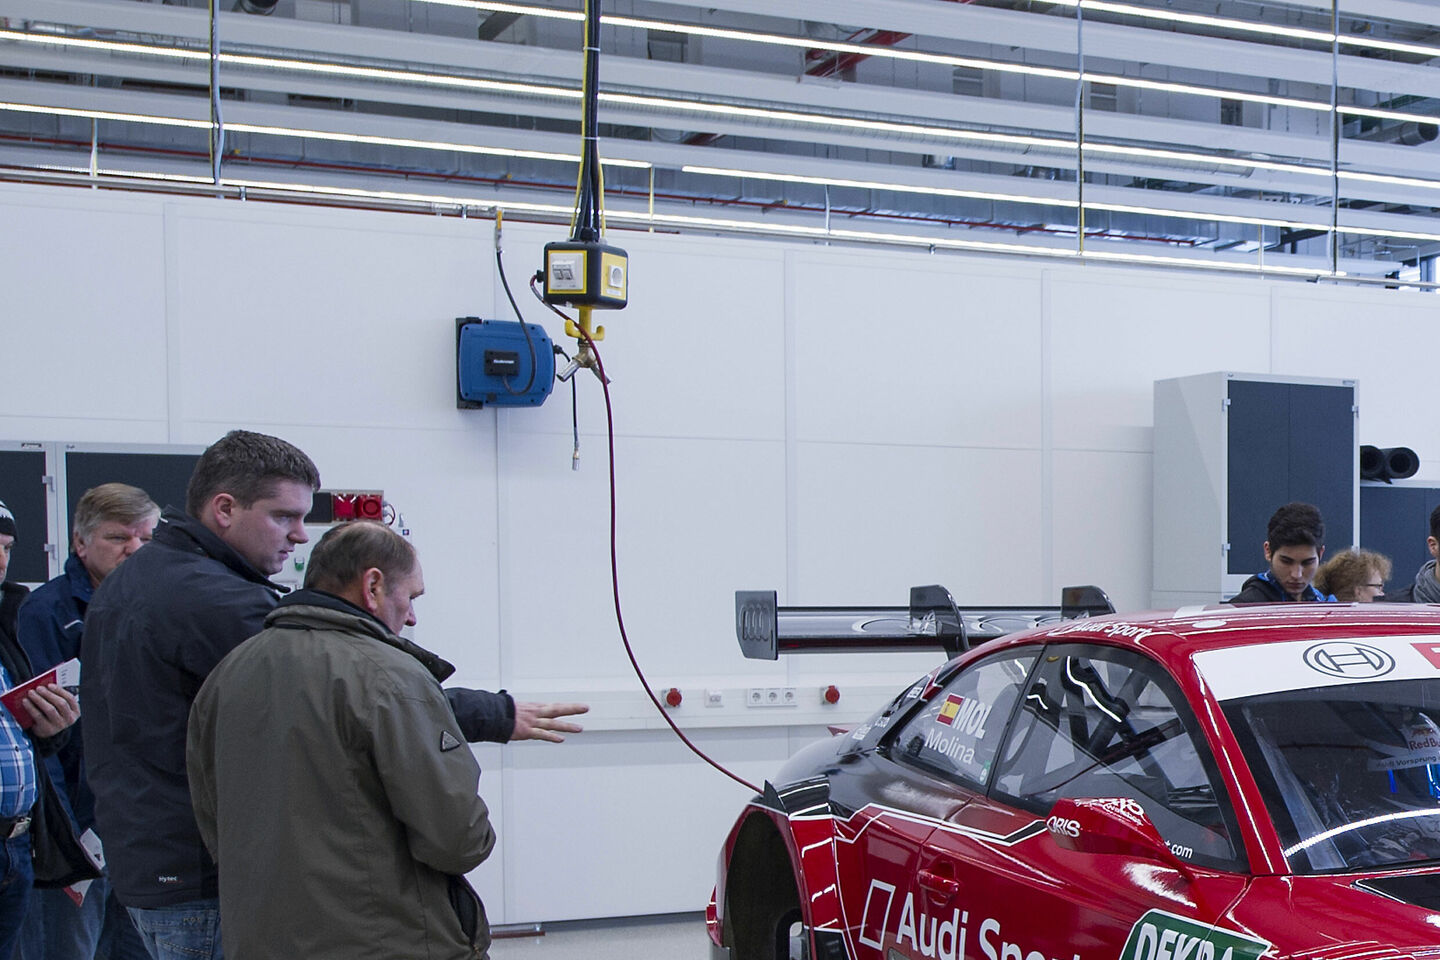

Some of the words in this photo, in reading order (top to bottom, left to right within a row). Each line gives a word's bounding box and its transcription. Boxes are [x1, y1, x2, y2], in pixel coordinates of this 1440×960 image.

[952, 697, 993, 739] MOL
[924, 728, 975, 765] Molina
[1046, 815, 1081, 838] ORIS
